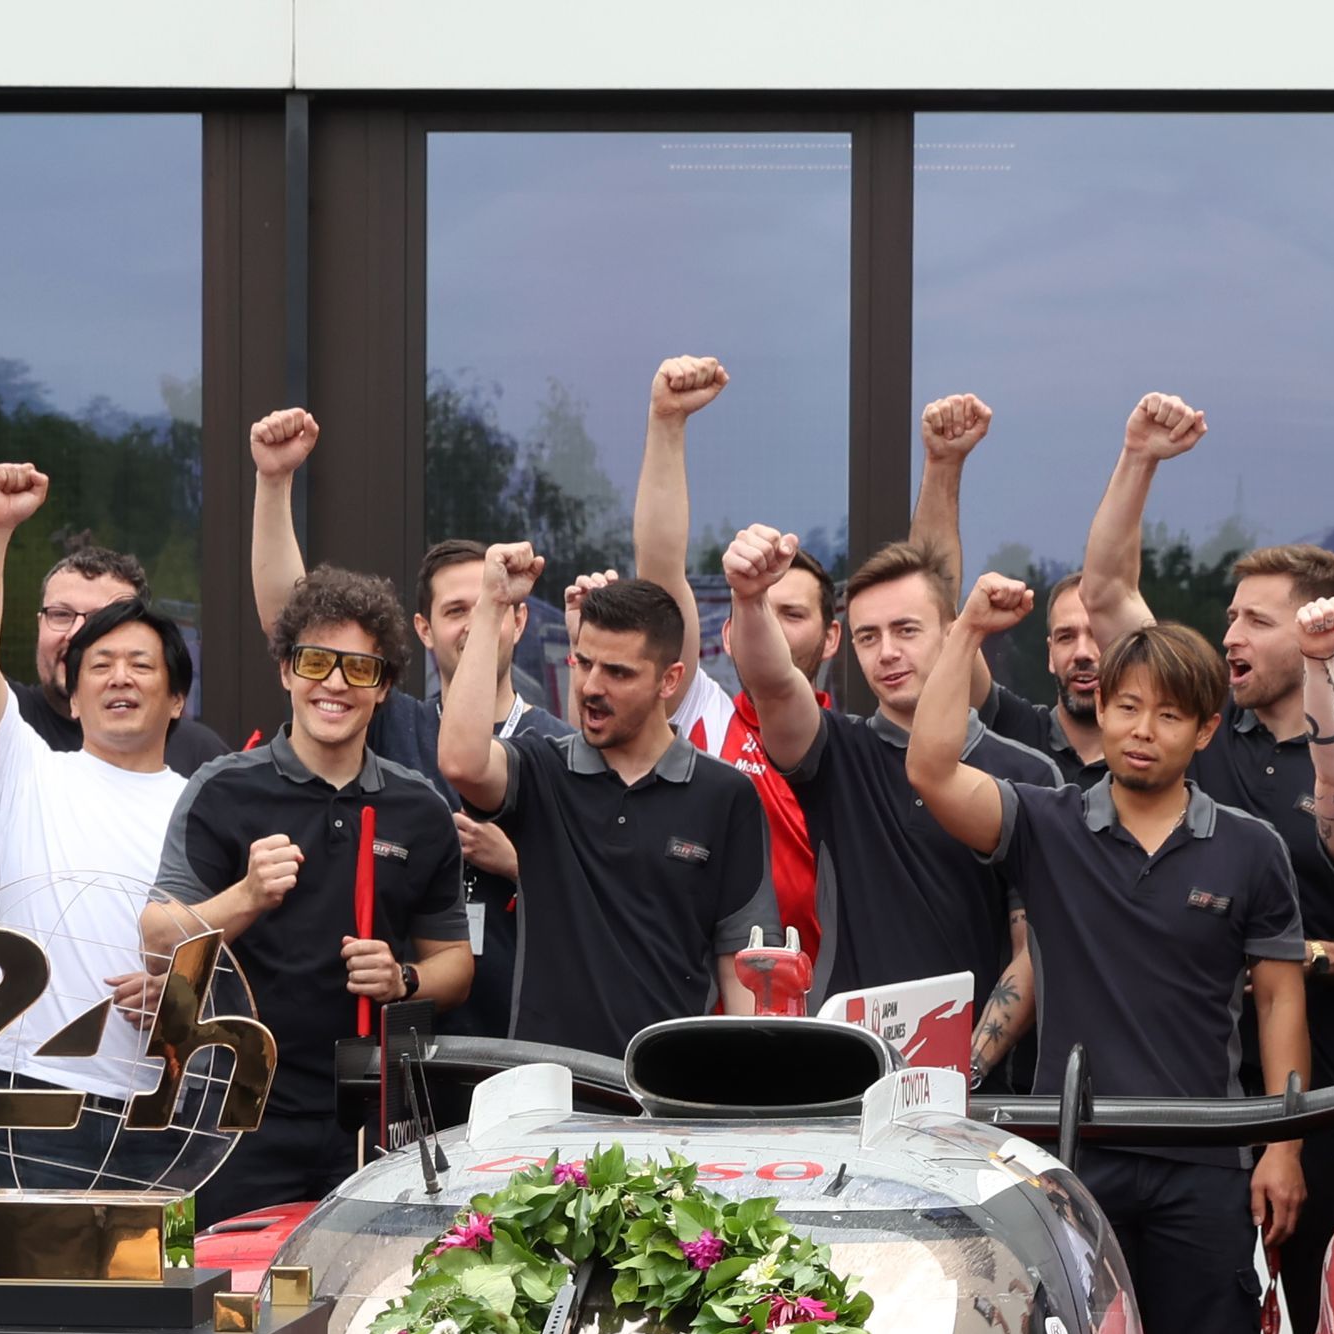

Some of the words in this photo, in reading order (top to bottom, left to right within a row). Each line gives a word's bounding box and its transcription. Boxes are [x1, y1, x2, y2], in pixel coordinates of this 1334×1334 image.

[882, 1001, 898, 1019] JAPAN
[883, 1023, 906, 1040] AIRLINES
[901, 1073, 931, 1108] TOYOTA
